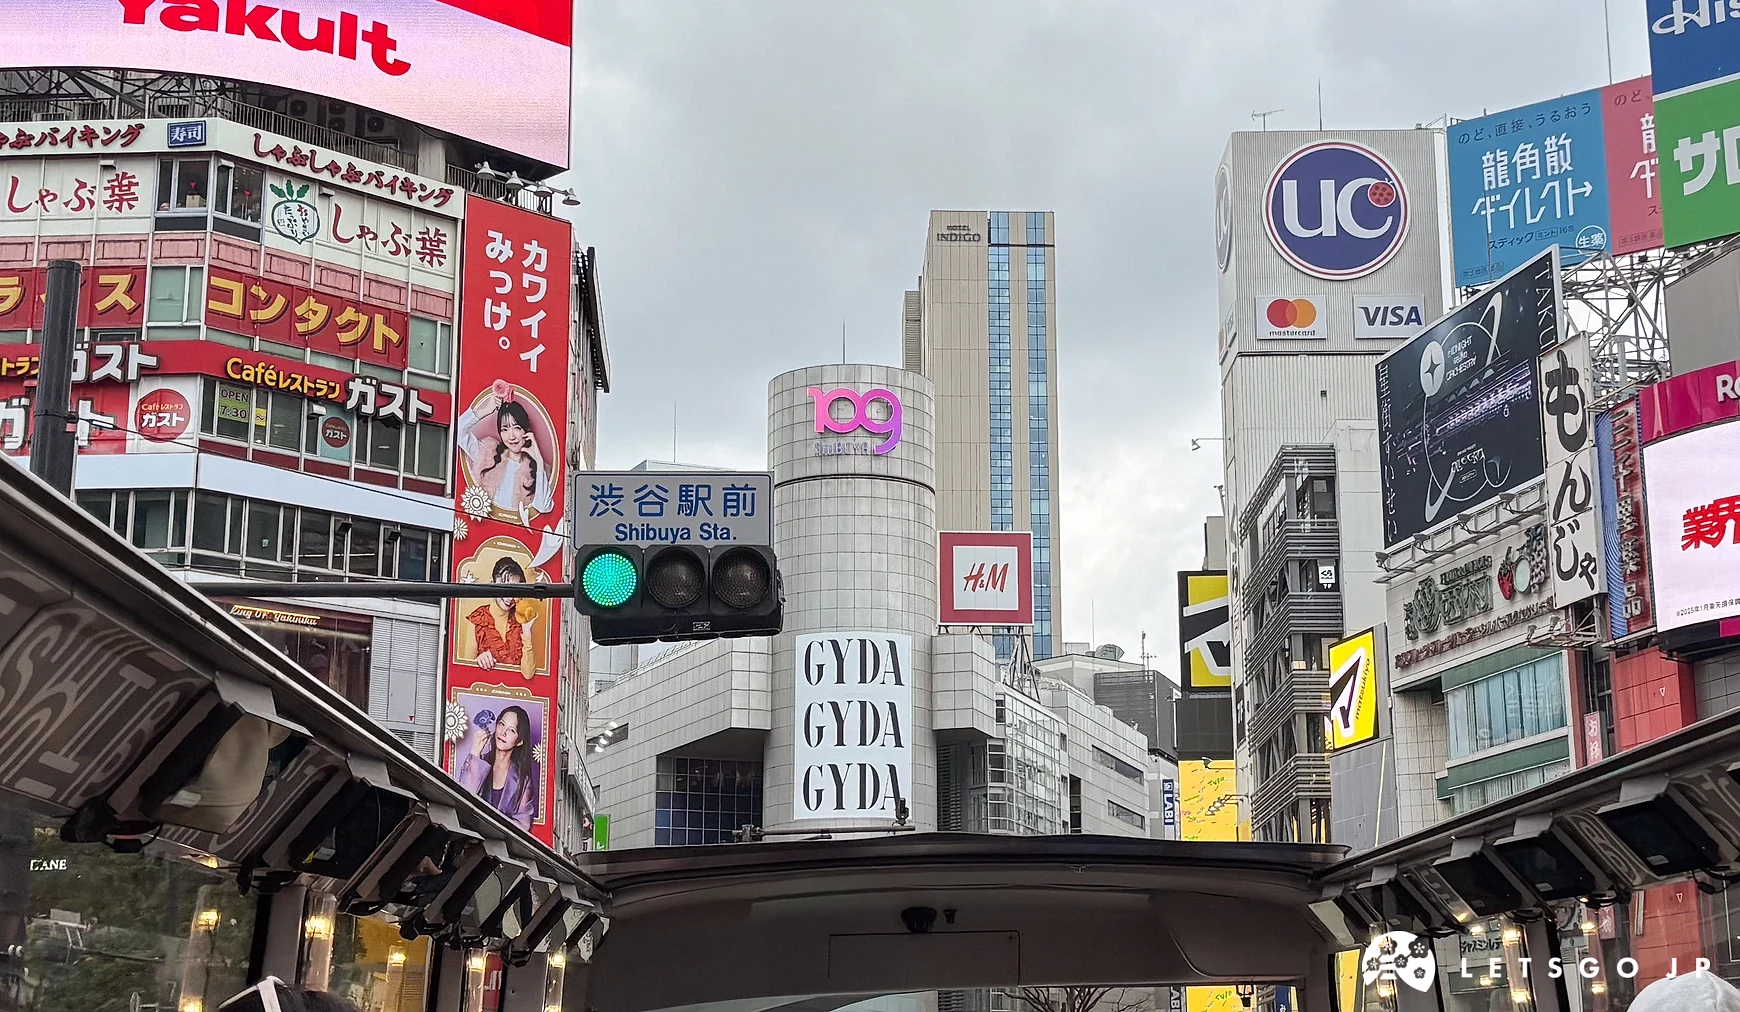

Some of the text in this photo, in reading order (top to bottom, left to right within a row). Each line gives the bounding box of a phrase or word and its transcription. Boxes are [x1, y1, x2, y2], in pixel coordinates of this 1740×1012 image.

[171, 124, 203, 142] 寿司
[1459, 103, 1591, 144] のど、直接、うるおう
[254, 133, 454, 208] しゃぶしゃぶバイキング
[1482, 132, 1574, 191] 龍角散
[8, 171, 139, 213] しゃぶ葉
[332, 203, 447, 267] しゃぶ葉
[936, 232, 982, 243] INDIGO
[0, 274, 138, 314] ラス
[483, 229, 514, 350] みつけ。
[519, 240, 548, 373] カワイイ
[208, 276, 404, 354] コンタクト
[1269, 329, 1316, 337] mastercard
[1358, 306, 1423, 326] VISA
[220, 404, 247, 419] 7:30
[221, 389, 249, 403] OPEN
[346, 377, 433, 423] ガスト
[0, 397, 115, 450] ガト
[141, 412, 185, 428] ガスト
[325, 429, 347, 440] ガスト
[807, 387, 903, 455] 109
[1545, 349, 1598, 591] もんじゃ
[589, 483, 757, 518] 渋谷駅前
[615, 523, 738, 544] Shibuya Sta.
[963, 562, 1009, 593] H&M
[804, 638, 905, 686] GYDA
[803, 700, 905, 749] GYDA
[802, 763, 901, 812] GYDA
[1164, 793, 1174, 823] LABI
